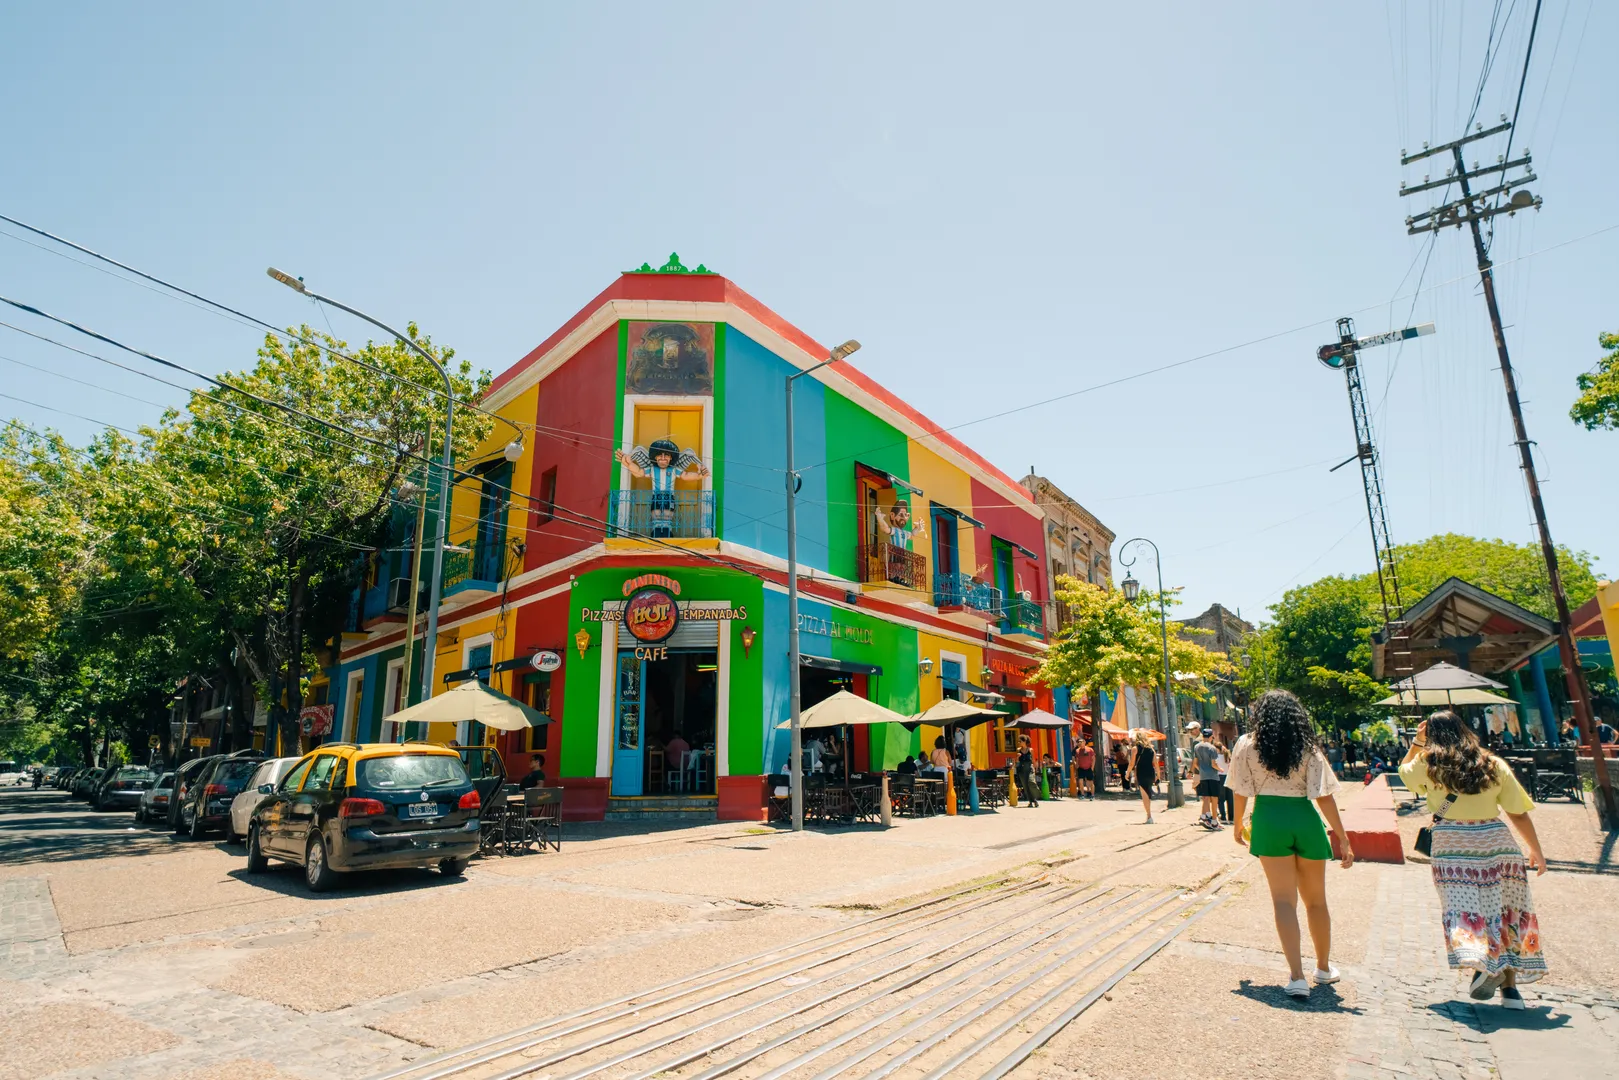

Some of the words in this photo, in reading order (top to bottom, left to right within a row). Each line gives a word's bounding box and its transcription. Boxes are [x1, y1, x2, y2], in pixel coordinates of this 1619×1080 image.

[582, 607, 622, 622] PIZZAS
[683, 605, 748, 620] EMPANADAS
[634, 646, 669, 662] CAFE
